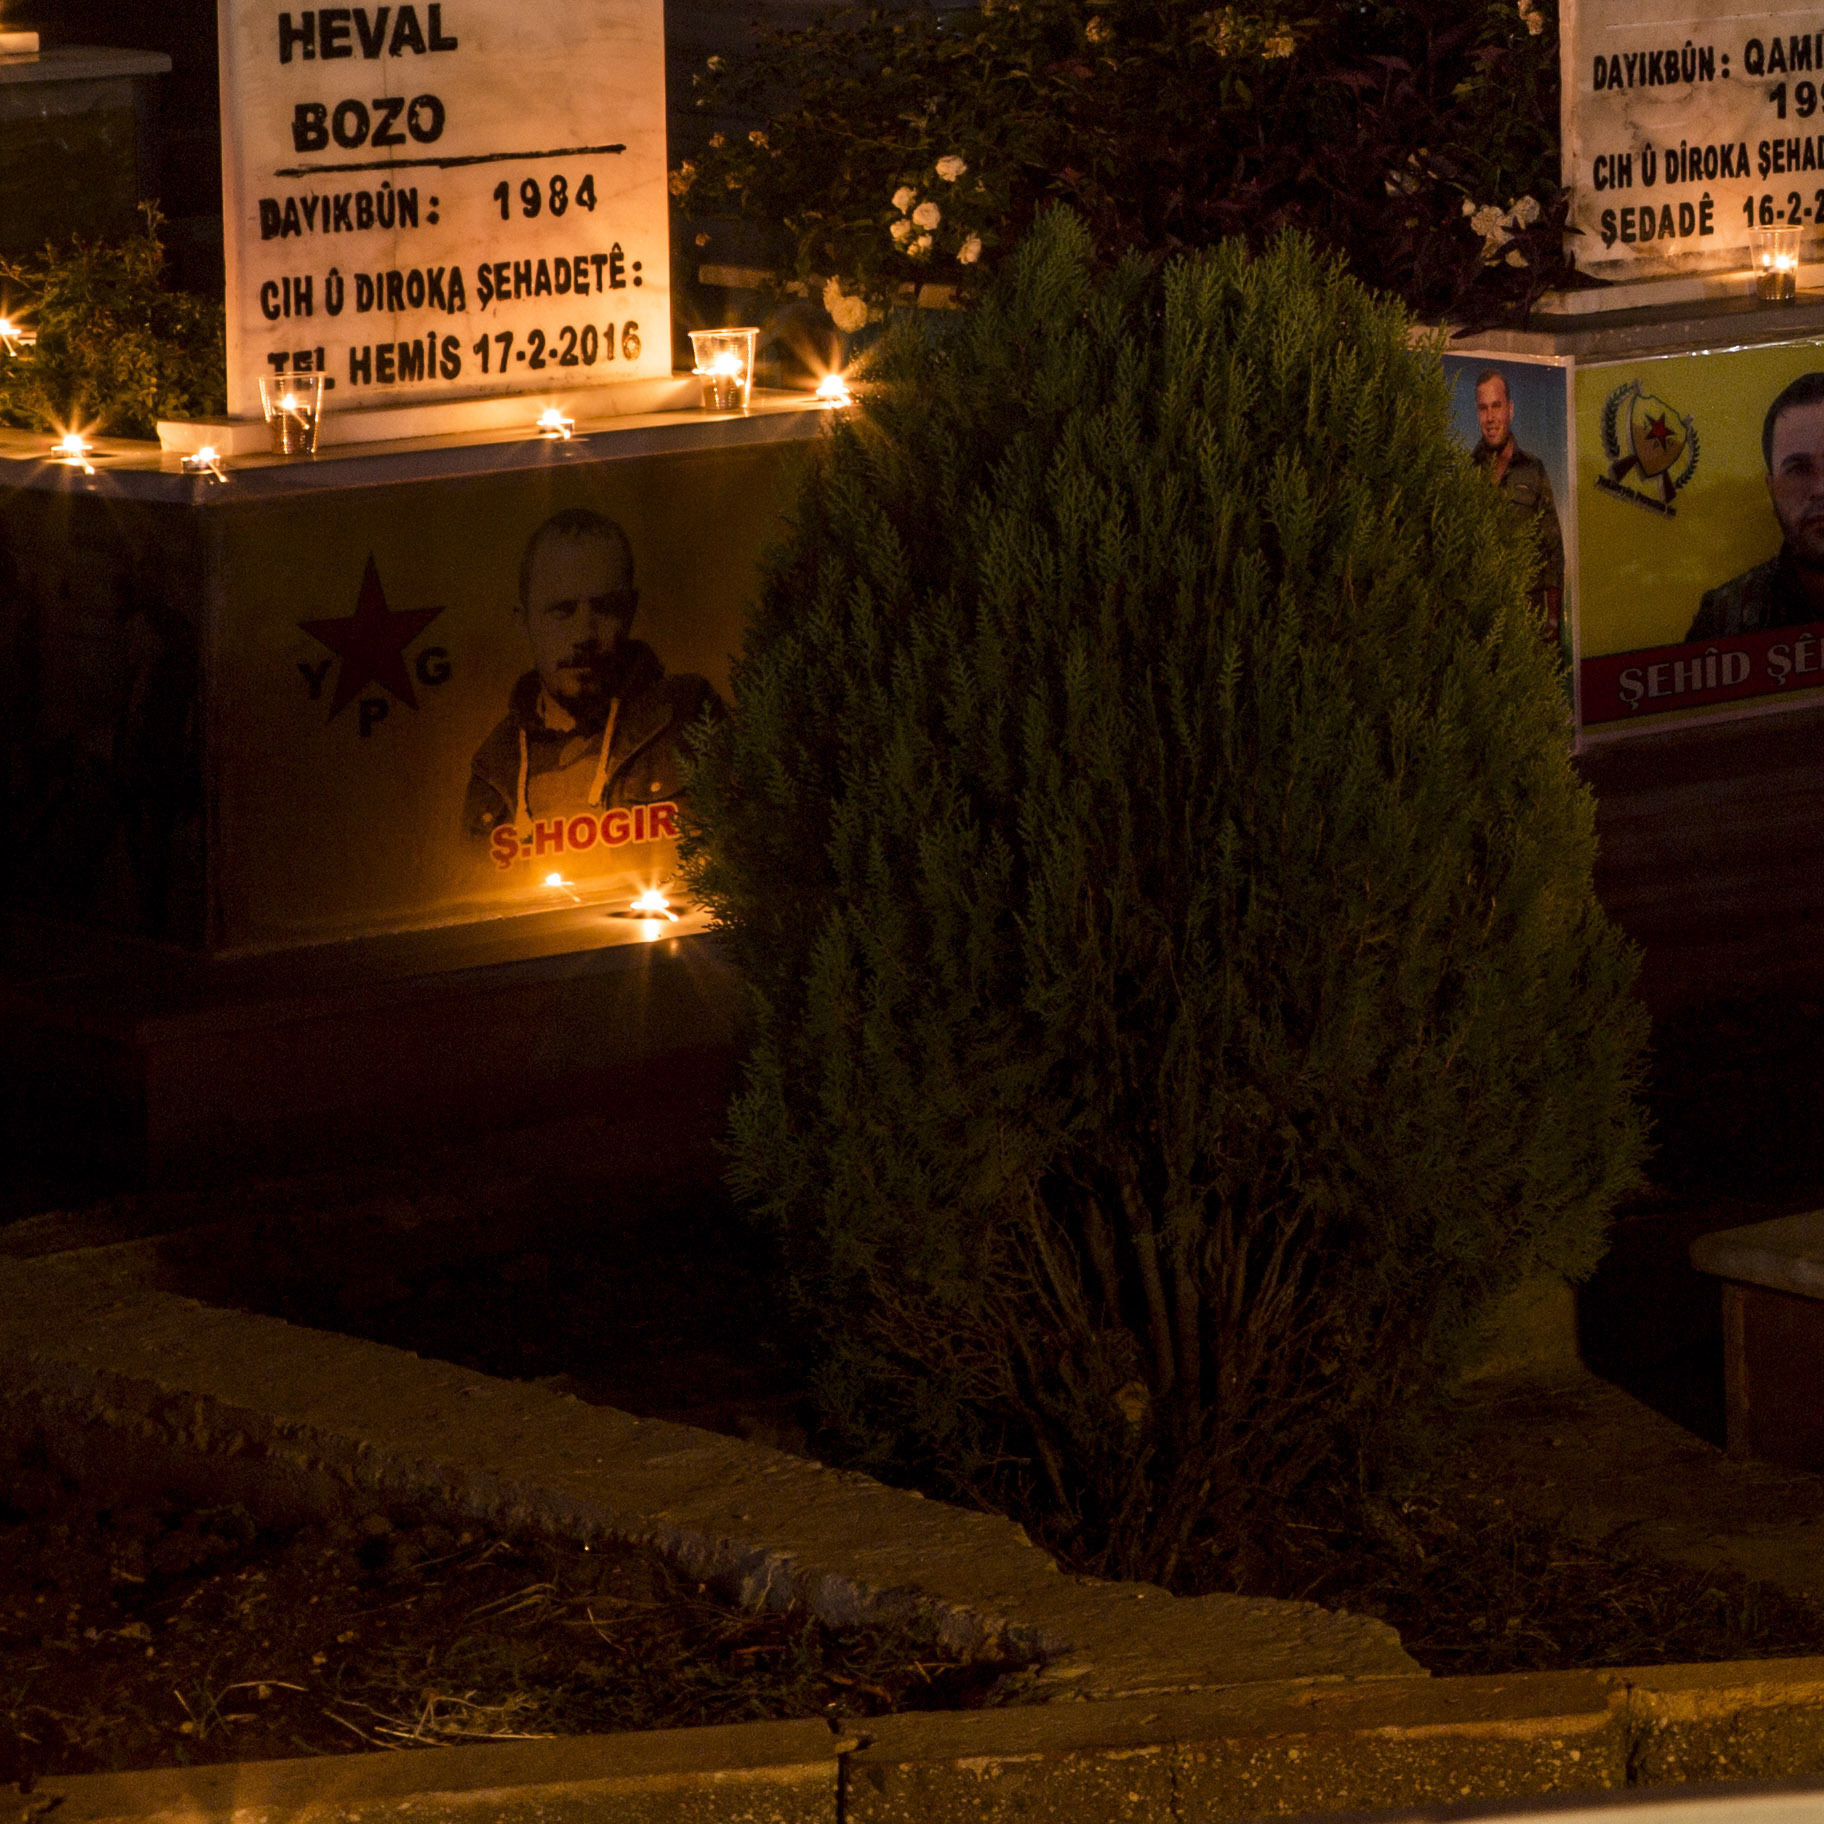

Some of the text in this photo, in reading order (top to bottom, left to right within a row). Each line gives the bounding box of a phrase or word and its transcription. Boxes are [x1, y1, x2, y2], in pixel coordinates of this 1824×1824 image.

[279, 4, 458, 63] HEVAL
[292, 95, 445, 152] BOZO
[494, 176, 597, 220] 1984
[1601, 192, 1714, 247] ŞEDADÊ
[261, 278, 313, 320] CIH
[326, 263, 344, 316] Û
[473, 322, 642, 373] 17-2-2016
[1618, 647, 1751, 711] ŞEHÎD
